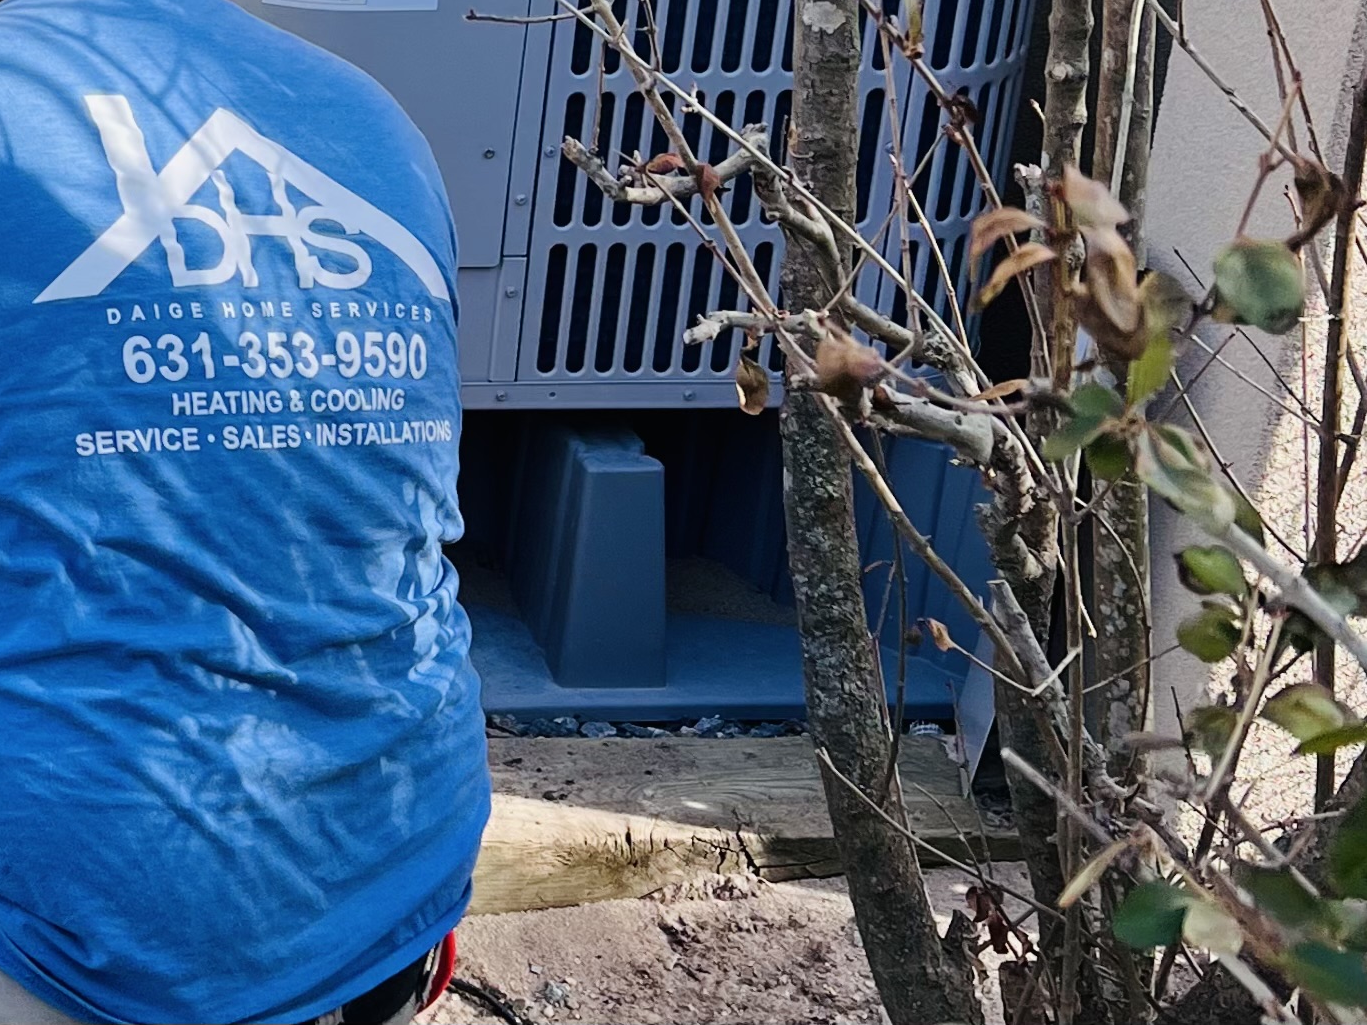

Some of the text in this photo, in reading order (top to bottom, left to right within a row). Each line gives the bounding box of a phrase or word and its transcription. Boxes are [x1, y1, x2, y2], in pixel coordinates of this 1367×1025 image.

[160, 169, 373, 289] DHS
[107, 301, 433, 325] DAIGE HOME SERVICES
[122, 331, 428, 383] 631-353-9590
[172, 388, 406, 416] HEATING & COOLING
[75, 420, 453, 457] SERVICE SALES INSTALLATIONS
